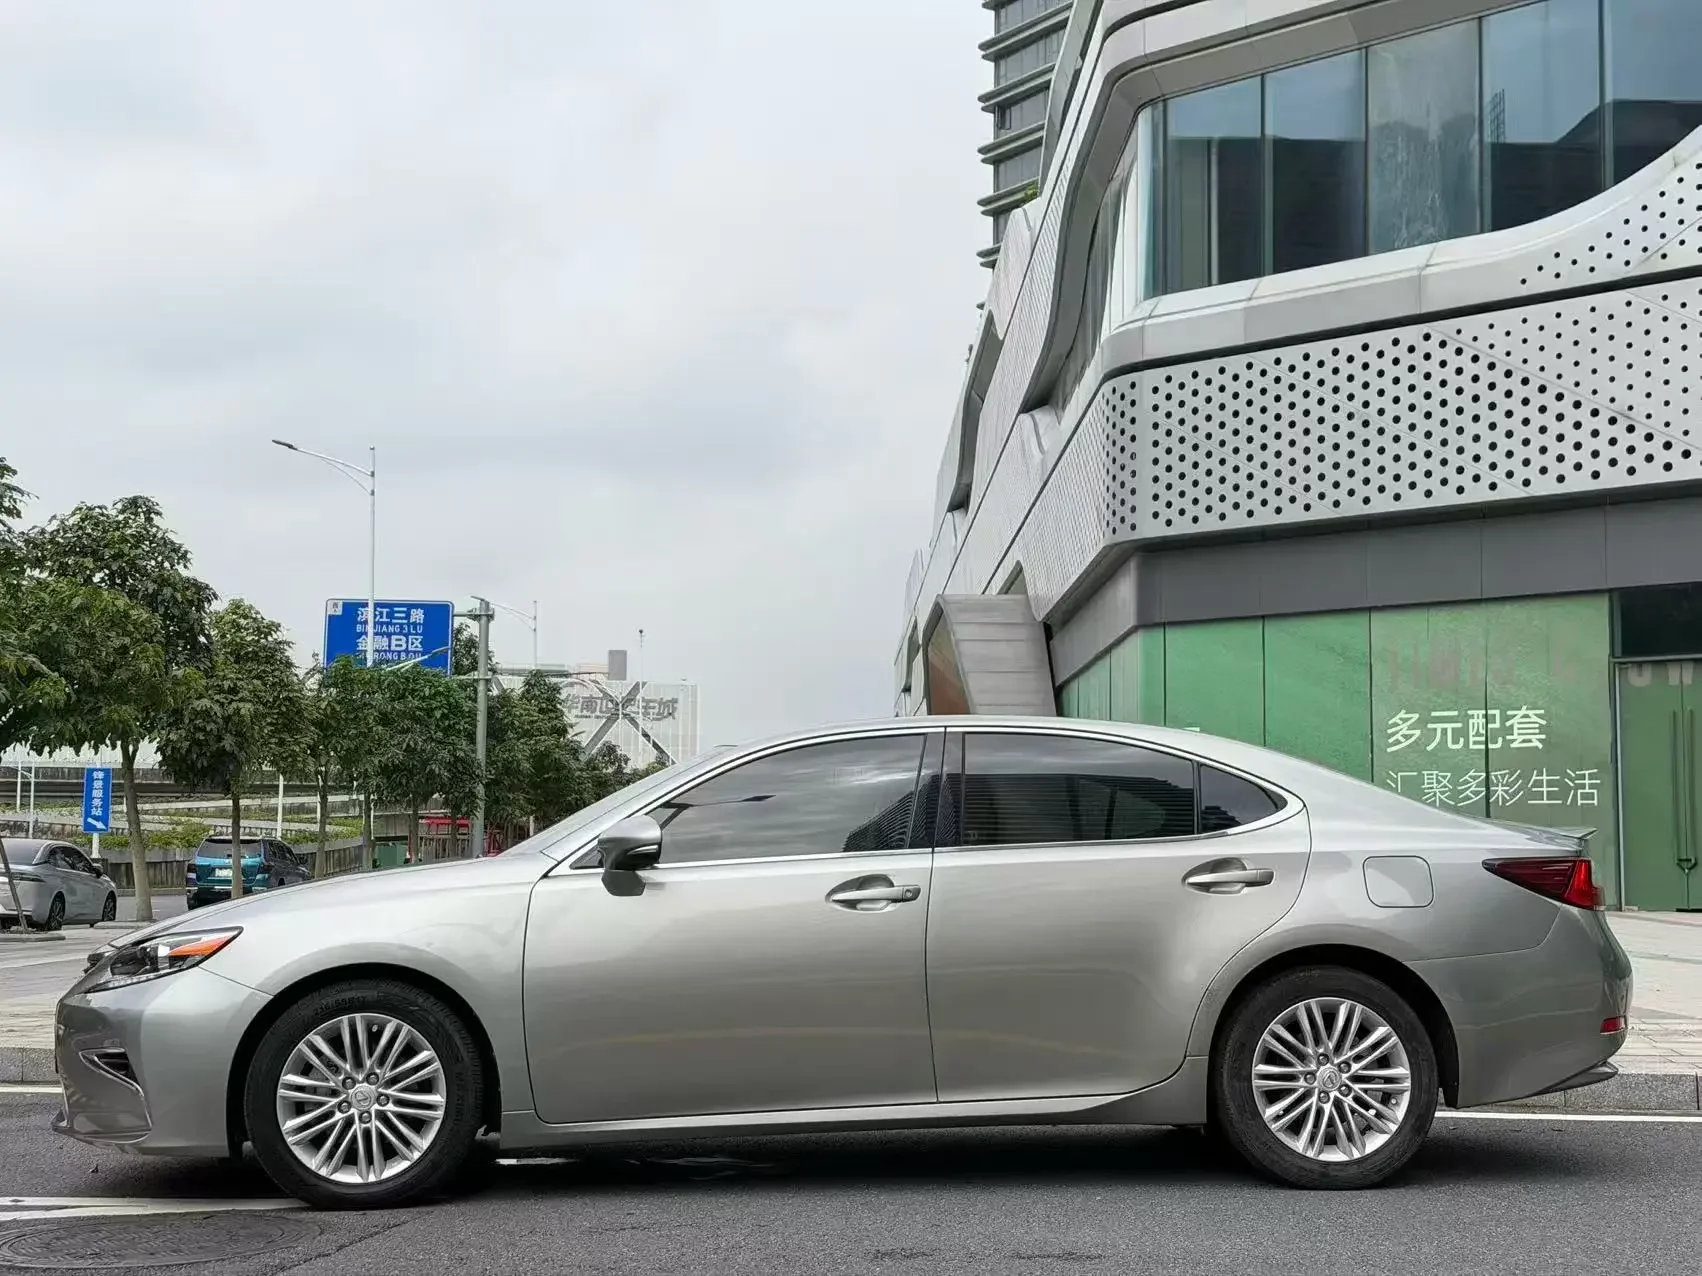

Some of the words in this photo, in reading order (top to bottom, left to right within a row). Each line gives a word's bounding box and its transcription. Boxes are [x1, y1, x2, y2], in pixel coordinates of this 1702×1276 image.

[356, 607, 425, 624] 滨江三路
[402, 624, 408, 633] 3
[410, 624, 423, 633] LU
[356, 635, 424, 651] 金融B区
[1385, 704, 1548, 754] 多元配套
[1385, 767, 1602, 807] 汇聚多彩生活
